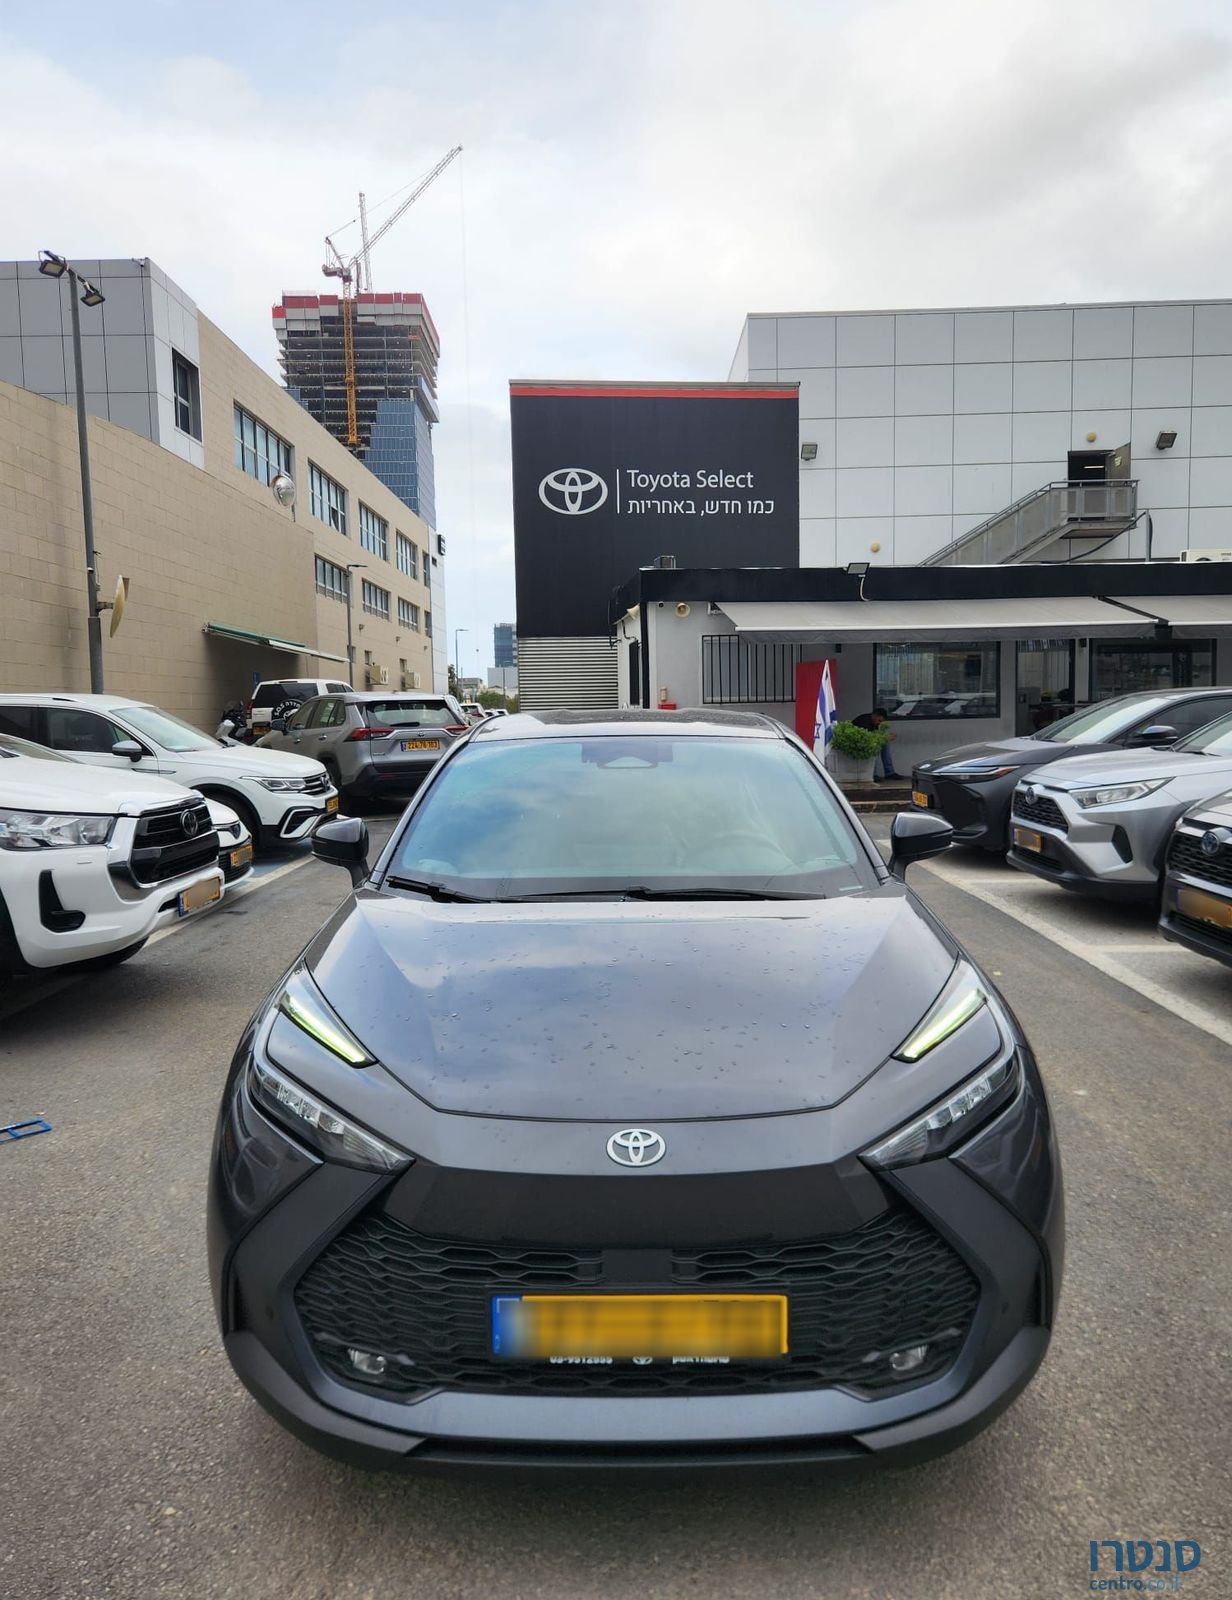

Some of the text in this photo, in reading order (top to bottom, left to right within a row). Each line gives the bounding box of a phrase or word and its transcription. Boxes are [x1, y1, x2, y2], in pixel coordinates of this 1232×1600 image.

[627, 469, 754, 492] Toyota Select
[627, 500, 775, 516] כמו חדש, באחריות
